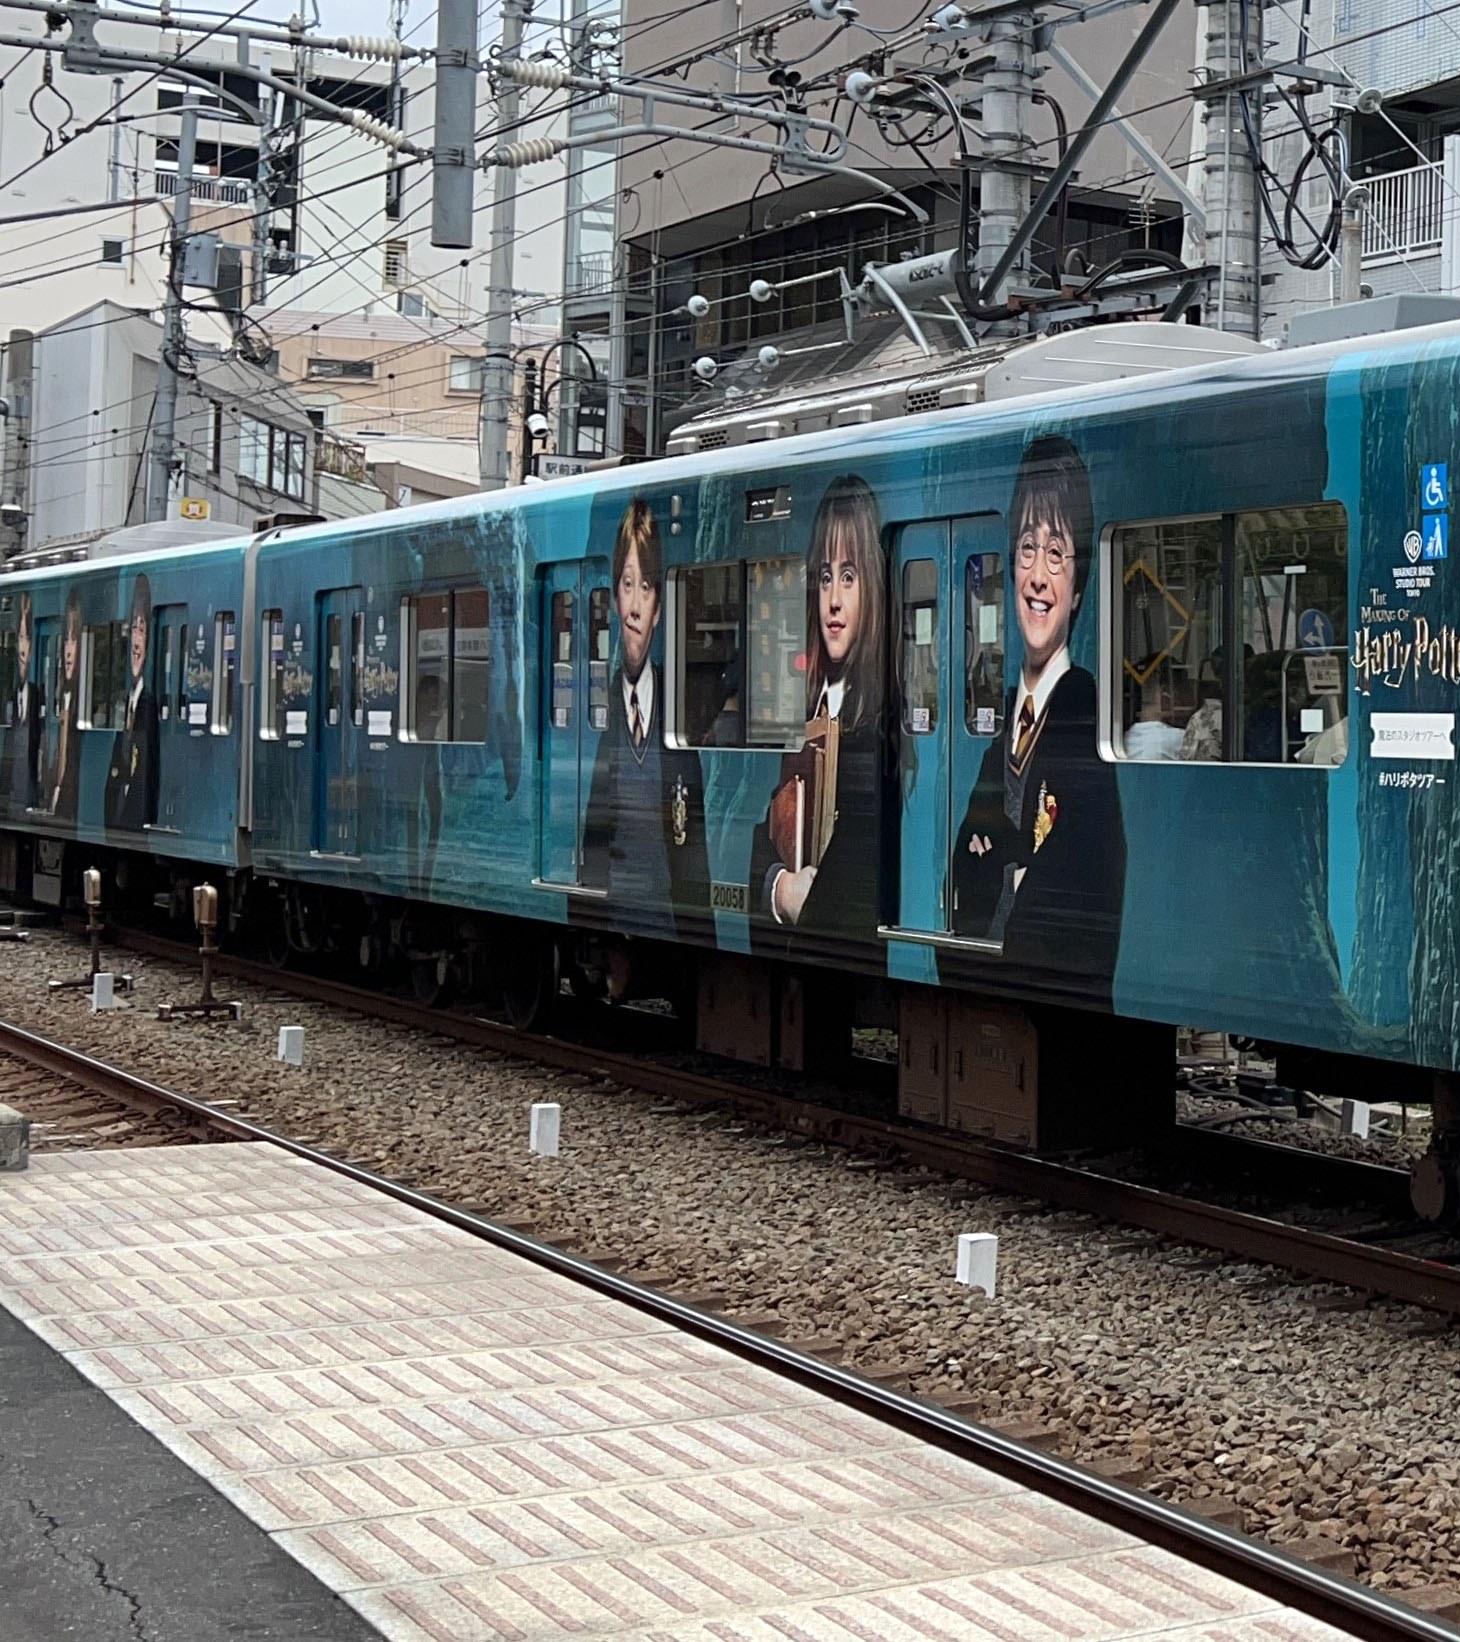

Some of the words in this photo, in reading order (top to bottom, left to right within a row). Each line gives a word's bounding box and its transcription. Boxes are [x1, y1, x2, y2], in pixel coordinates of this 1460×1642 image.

[1350, 626, 1412, 696] Harry
[1378, 770, 1446, 789] #ハリポタツアー
[713, 886, 745, 910] 20058
